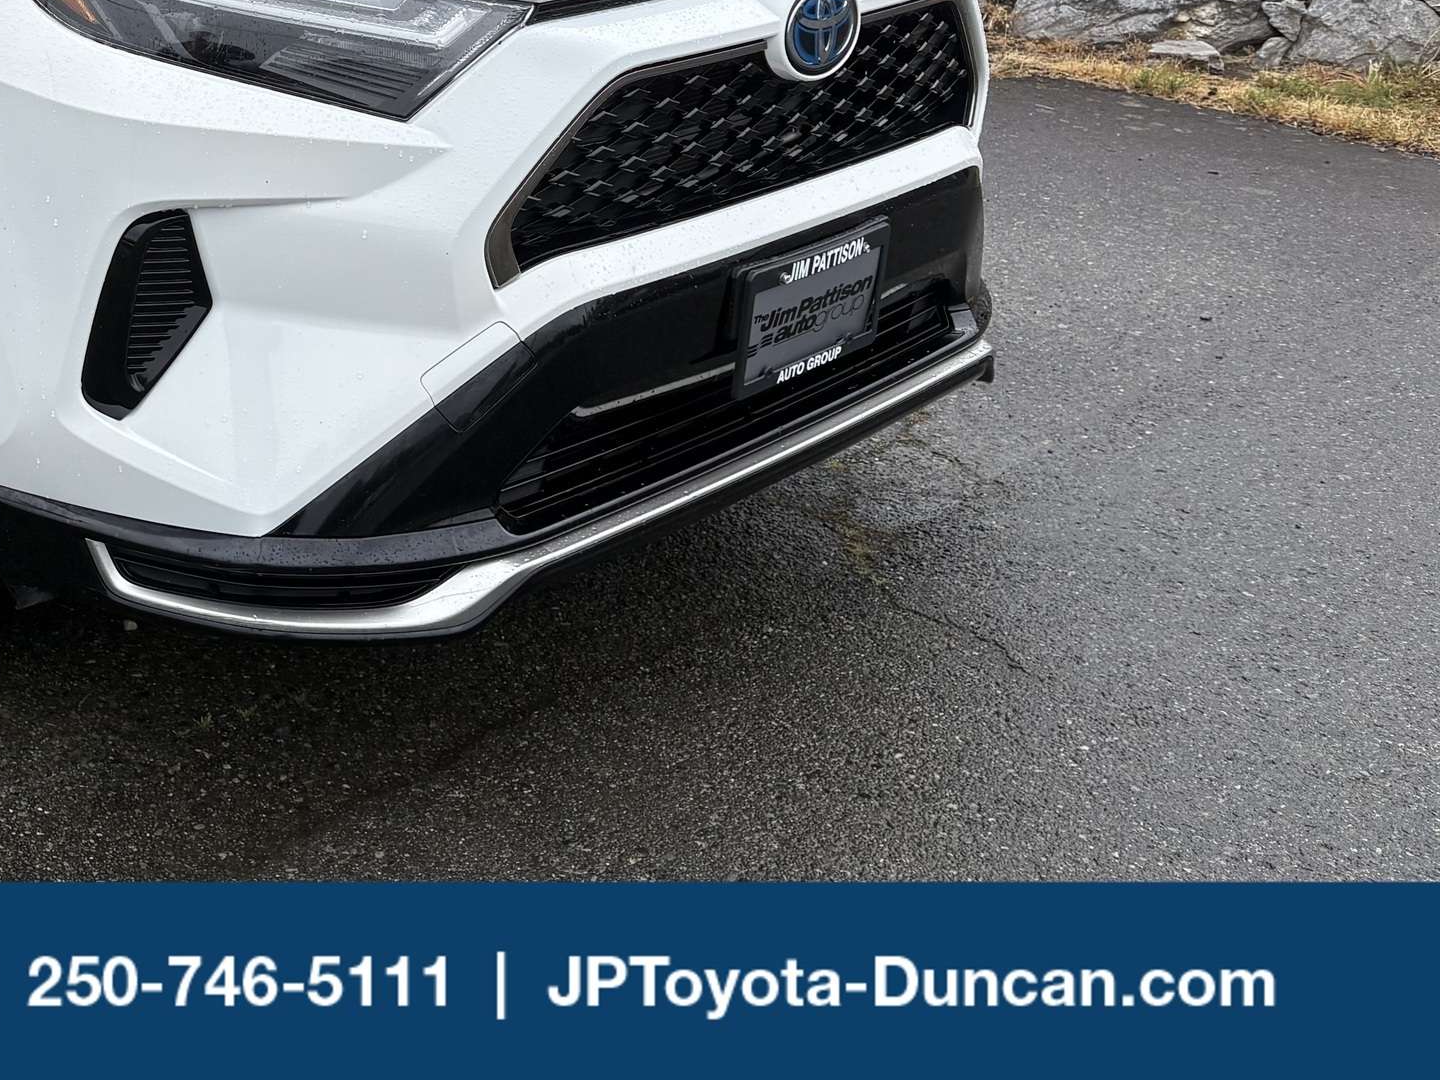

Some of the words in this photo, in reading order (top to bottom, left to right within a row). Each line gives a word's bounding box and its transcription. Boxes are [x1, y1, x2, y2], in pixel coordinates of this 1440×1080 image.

[786, 258, 810, 284] JIM
[811, 237, 865, 275] PATTISON
[776, 361, 806, 384] AUTO
[806, 346, 842, 372] GROUP
